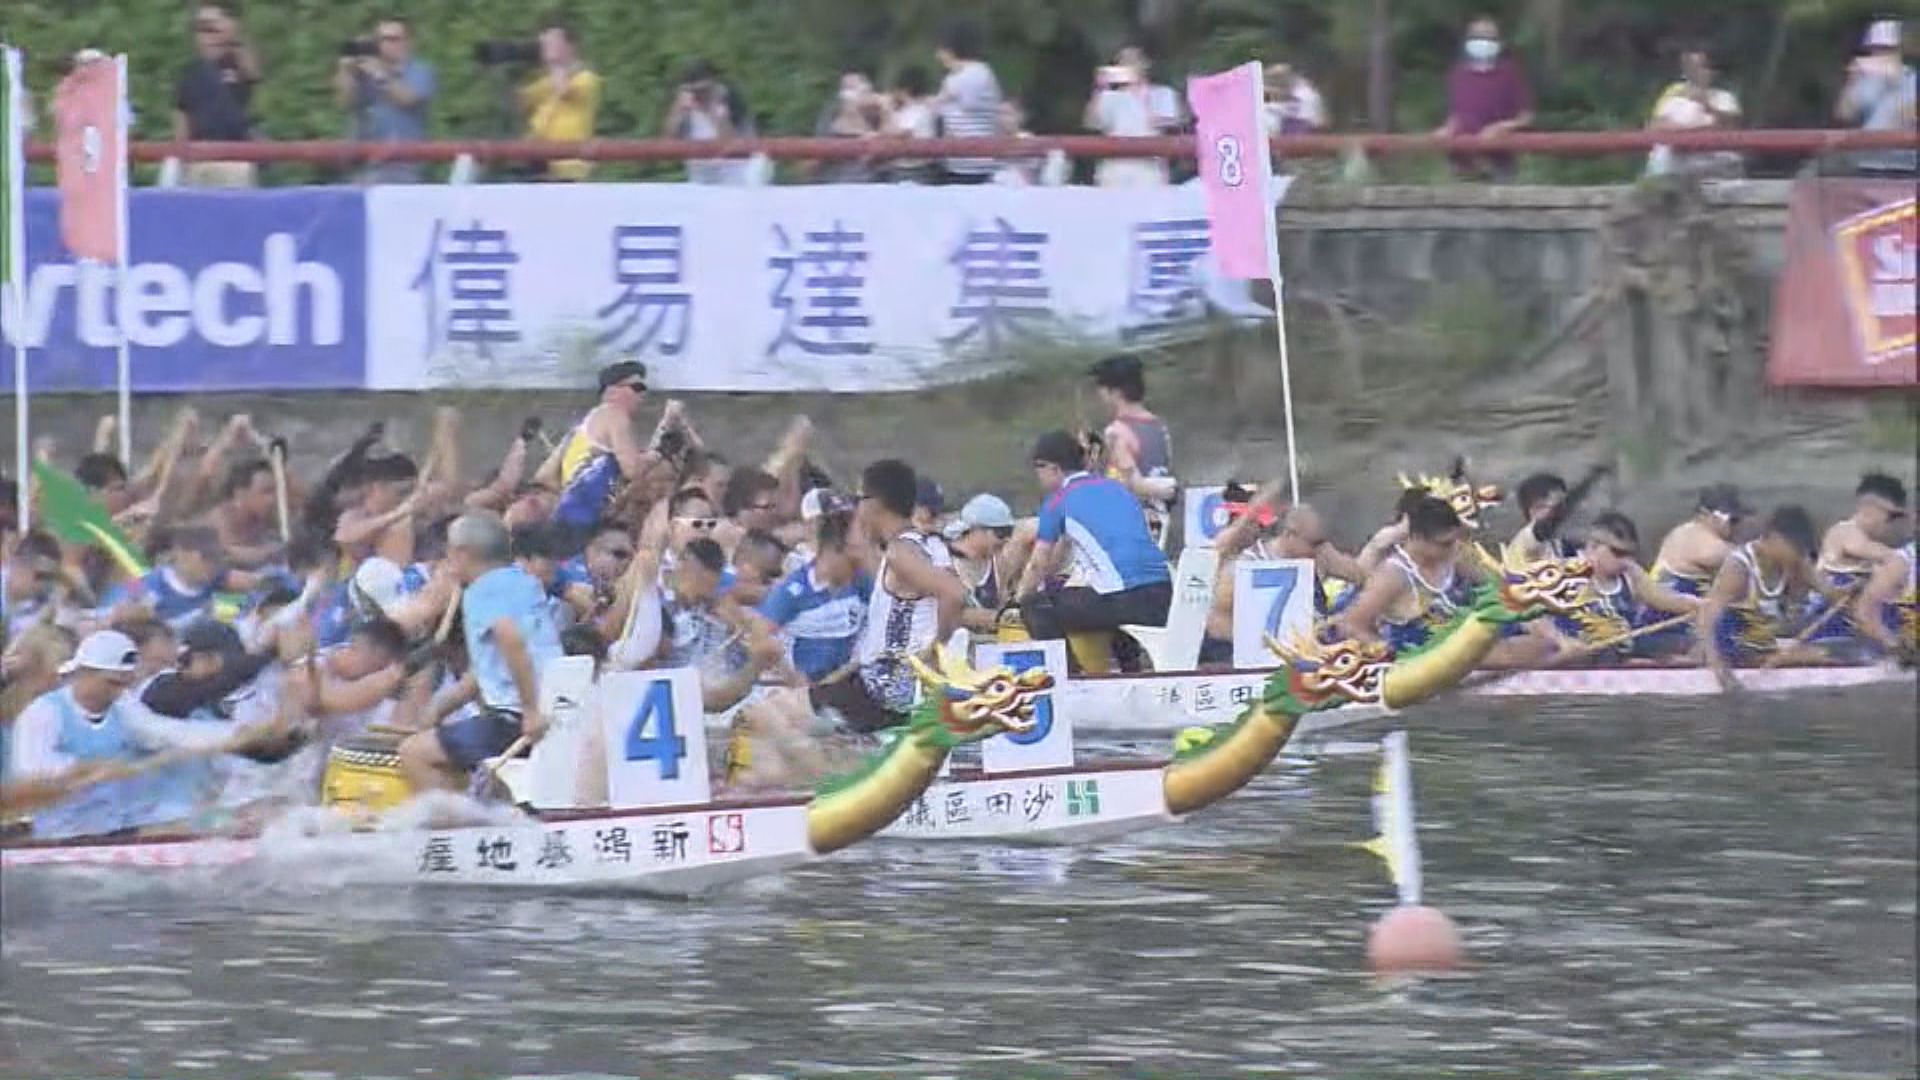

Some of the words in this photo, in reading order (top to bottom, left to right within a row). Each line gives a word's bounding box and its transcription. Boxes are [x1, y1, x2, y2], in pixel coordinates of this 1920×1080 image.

[1217, 134, 1243, 187] 8
[1251, 566, 1298, 640] 7
[624, 678, 688, 780] 4
